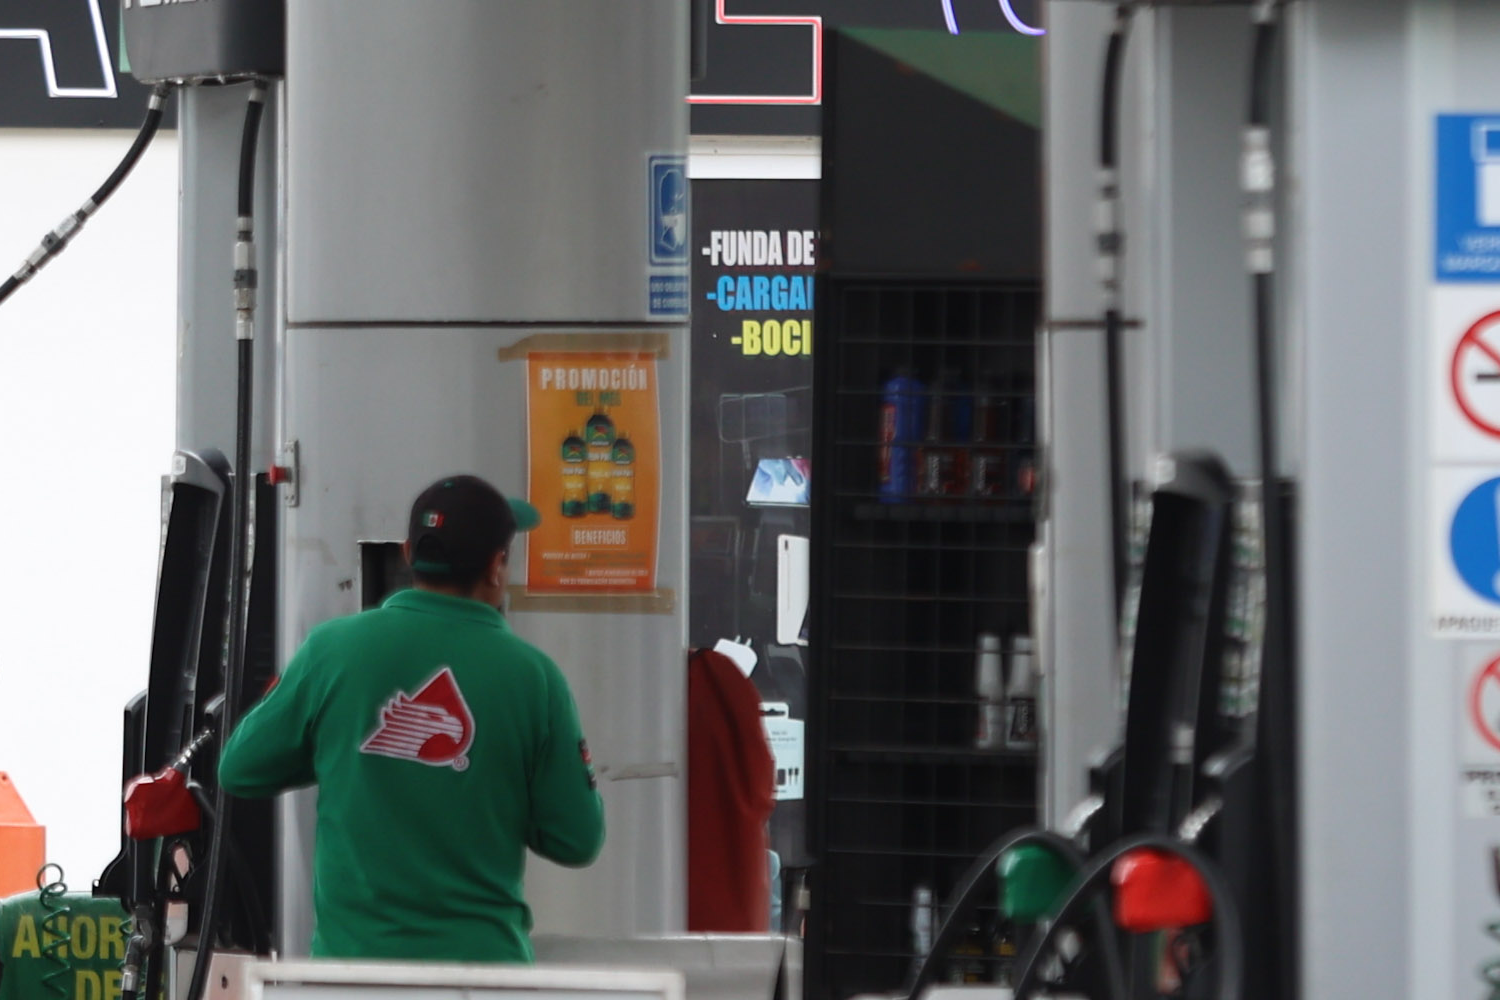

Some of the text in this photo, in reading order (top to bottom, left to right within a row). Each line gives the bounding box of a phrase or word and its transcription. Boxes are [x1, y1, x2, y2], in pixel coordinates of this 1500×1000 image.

[702, 230, 815, 266] -FUNDA DE
[541, 364, 648, 390] PROMOCIÓN
[574, 529, 627, 545] BENEFICIOS
